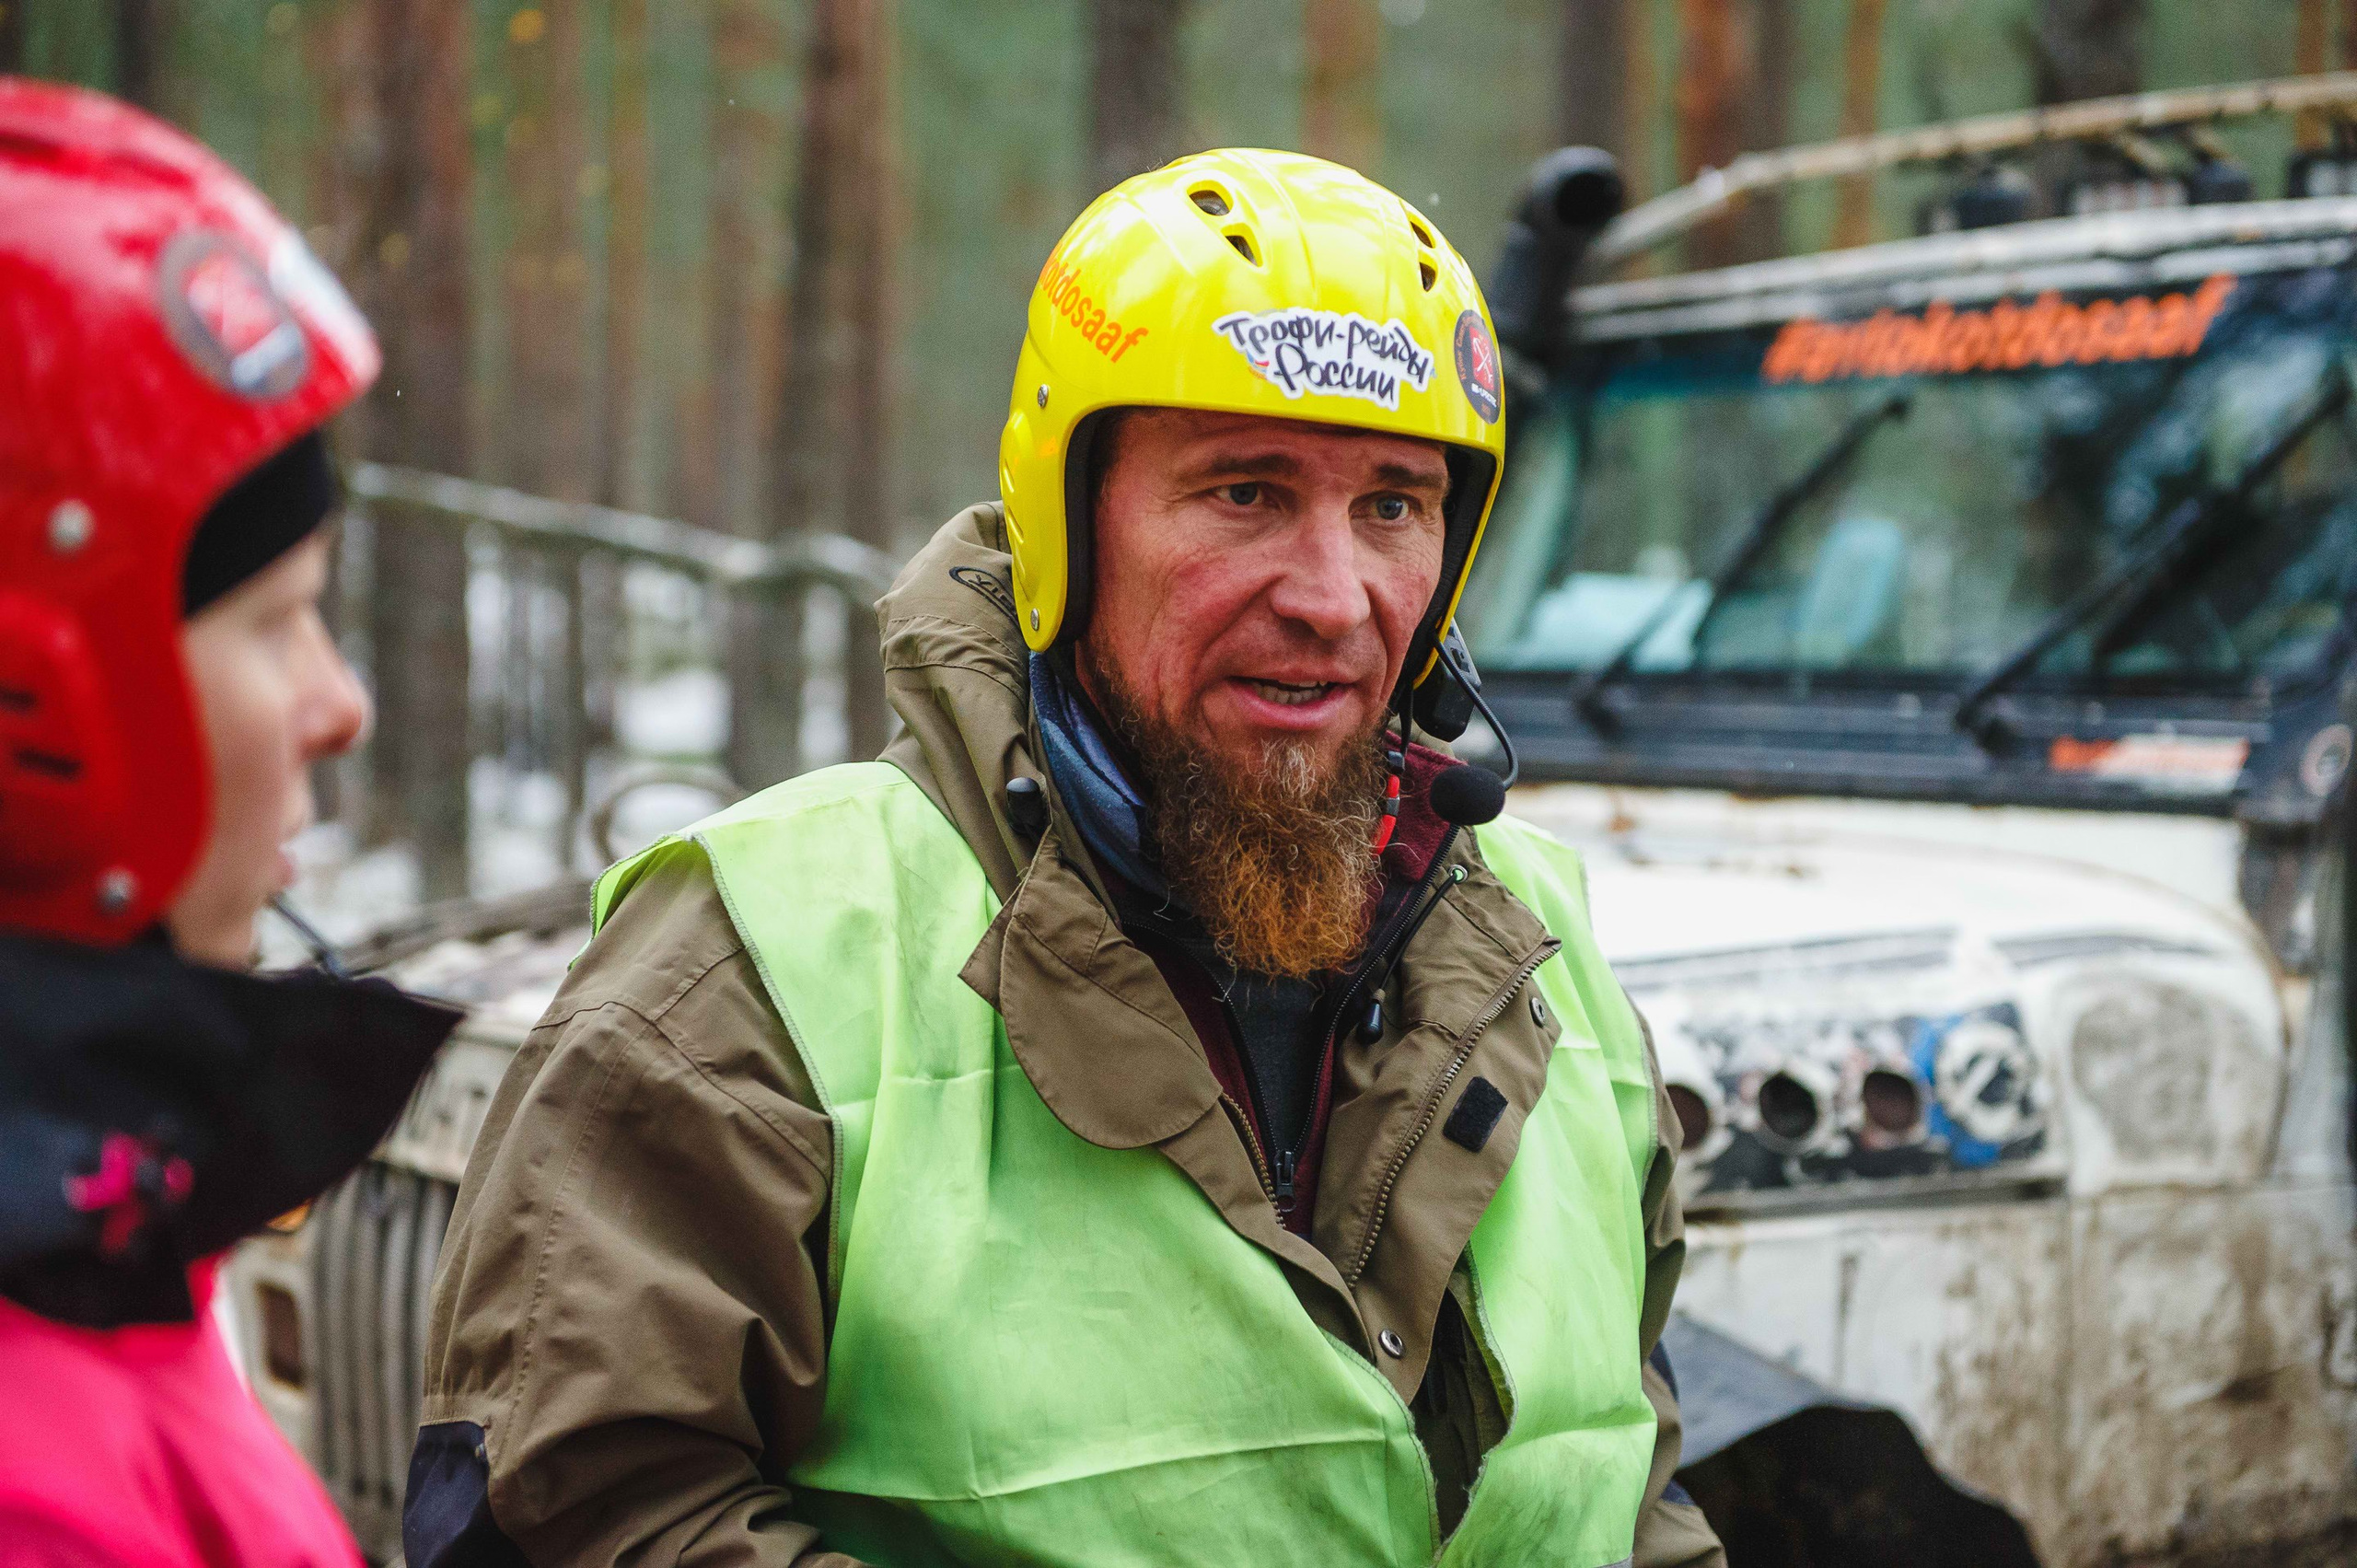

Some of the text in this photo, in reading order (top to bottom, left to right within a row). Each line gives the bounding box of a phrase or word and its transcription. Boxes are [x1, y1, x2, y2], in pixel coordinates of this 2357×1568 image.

[1039, 241, 1149, 364] otdosaaf
[1218, 315, 1430, 384] Трофи-рейды
[1273, 342, 1396, 402] России
